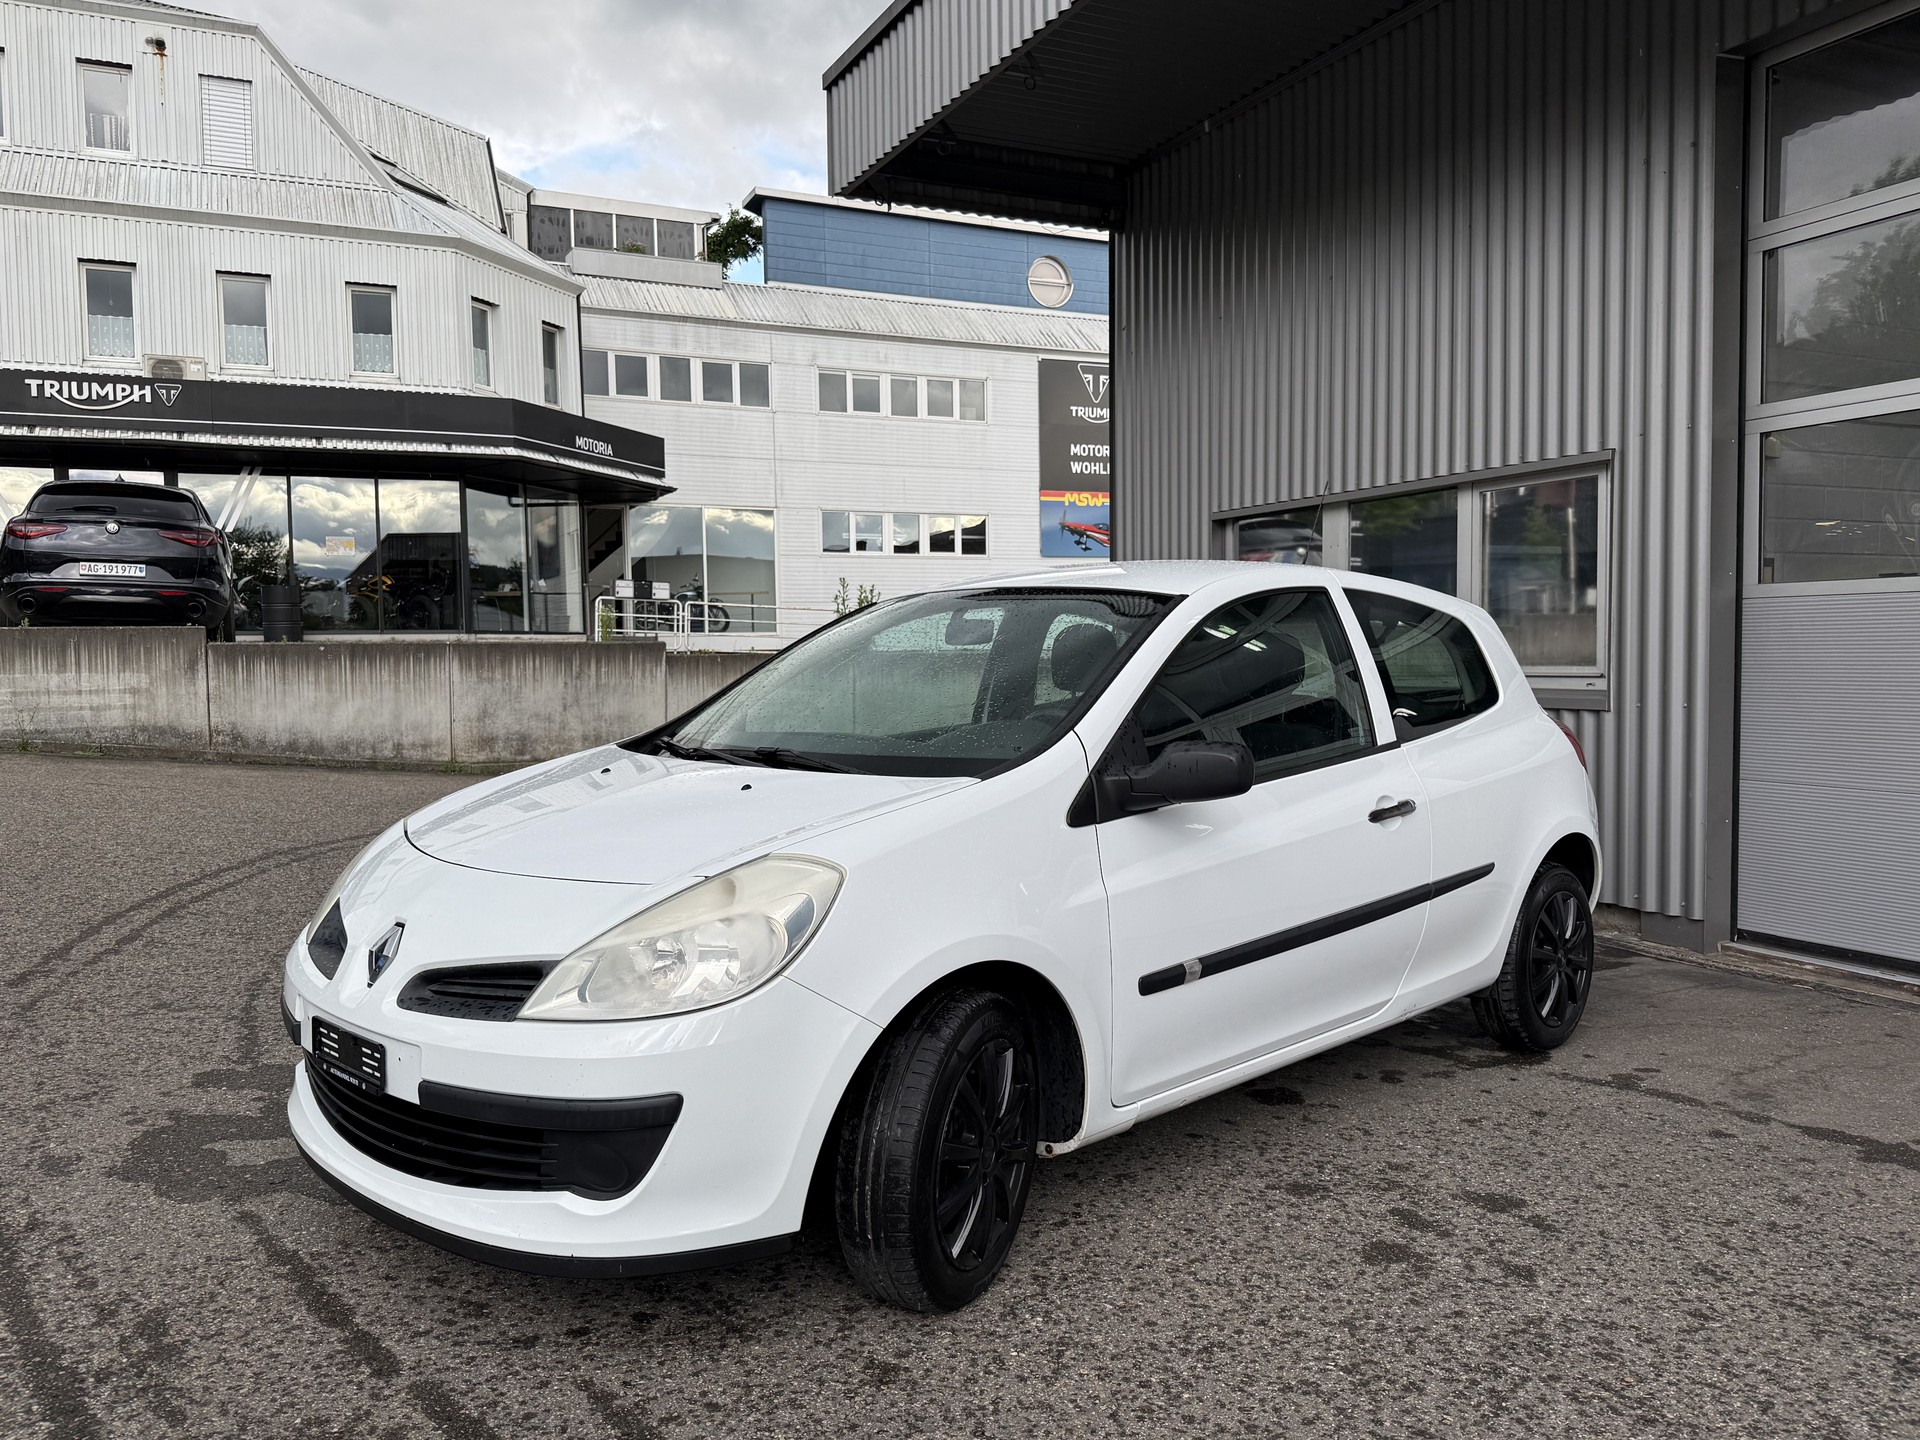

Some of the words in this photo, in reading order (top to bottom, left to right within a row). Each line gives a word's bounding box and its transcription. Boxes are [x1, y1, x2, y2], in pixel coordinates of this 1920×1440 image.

[25, 379, 151, 410] TRIUMPH
[1070, 406, 1109, 423] TRIUM
[576, 435, 613, 456] MOTORIA
[1070, 461, 1109, 475] WOHL
